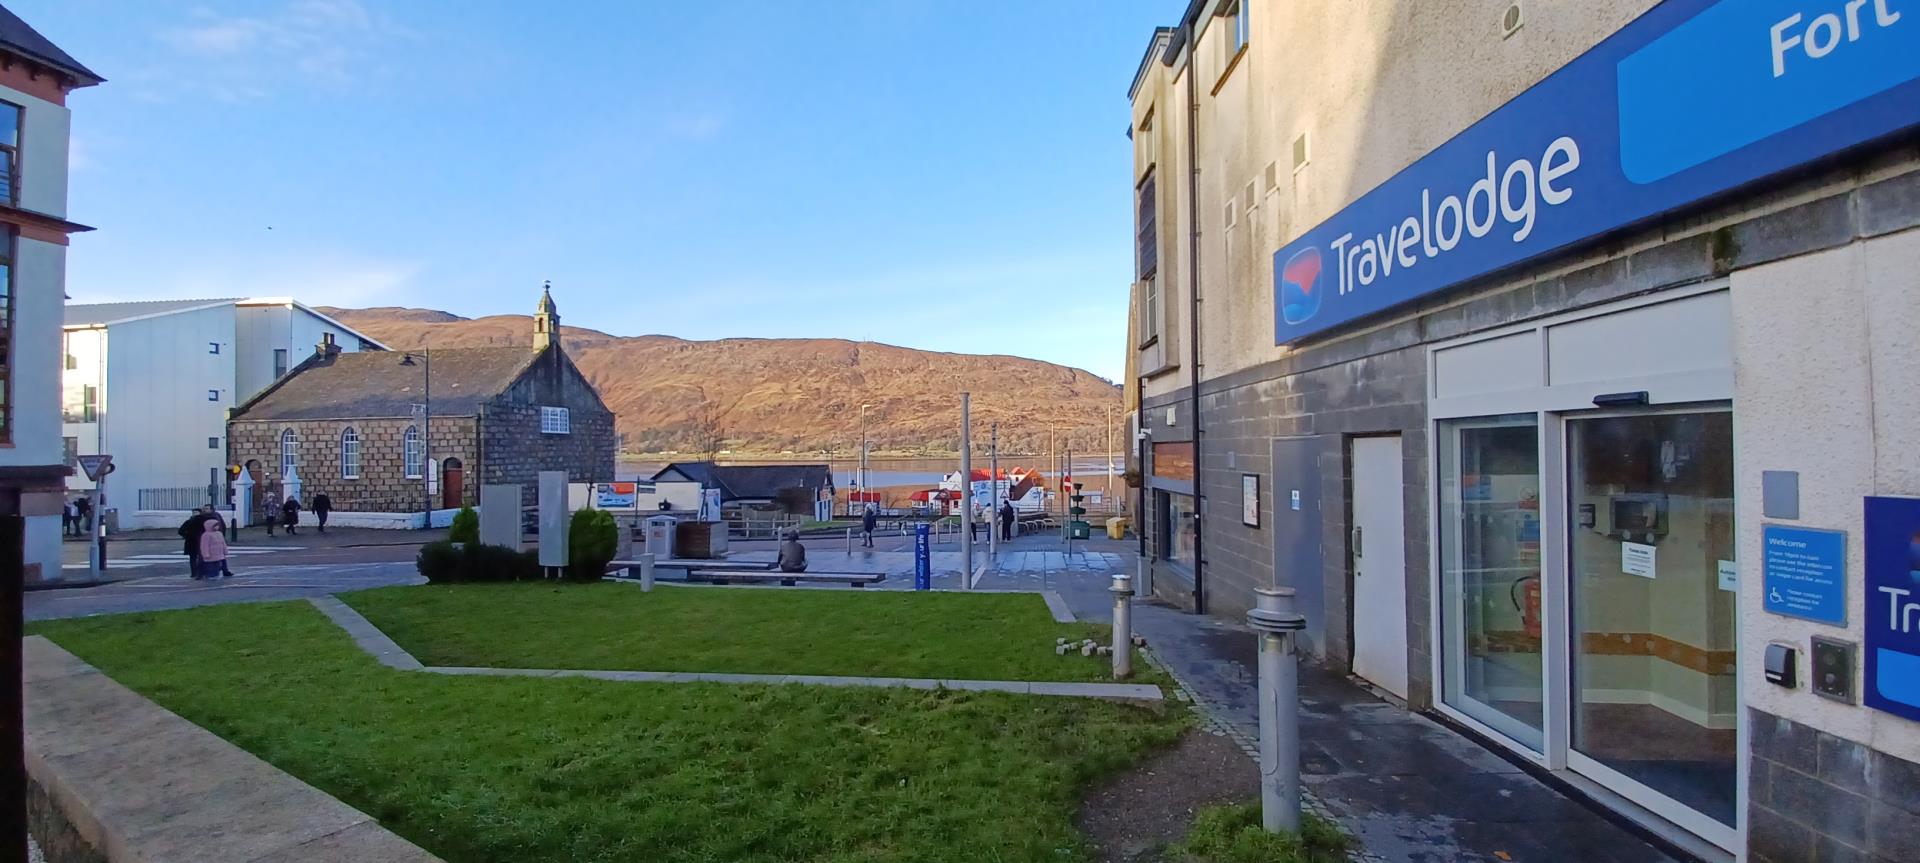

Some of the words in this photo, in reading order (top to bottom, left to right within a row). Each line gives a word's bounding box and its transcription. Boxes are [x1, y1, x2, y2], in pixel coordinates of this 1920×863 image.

[1770, 0, 1901, 78] Fort
[1330, 136, 1581, 297] Travelodge
[1768, 538, 1807, 548] Welcome
[1878, 586, 1920, 633] Tr
